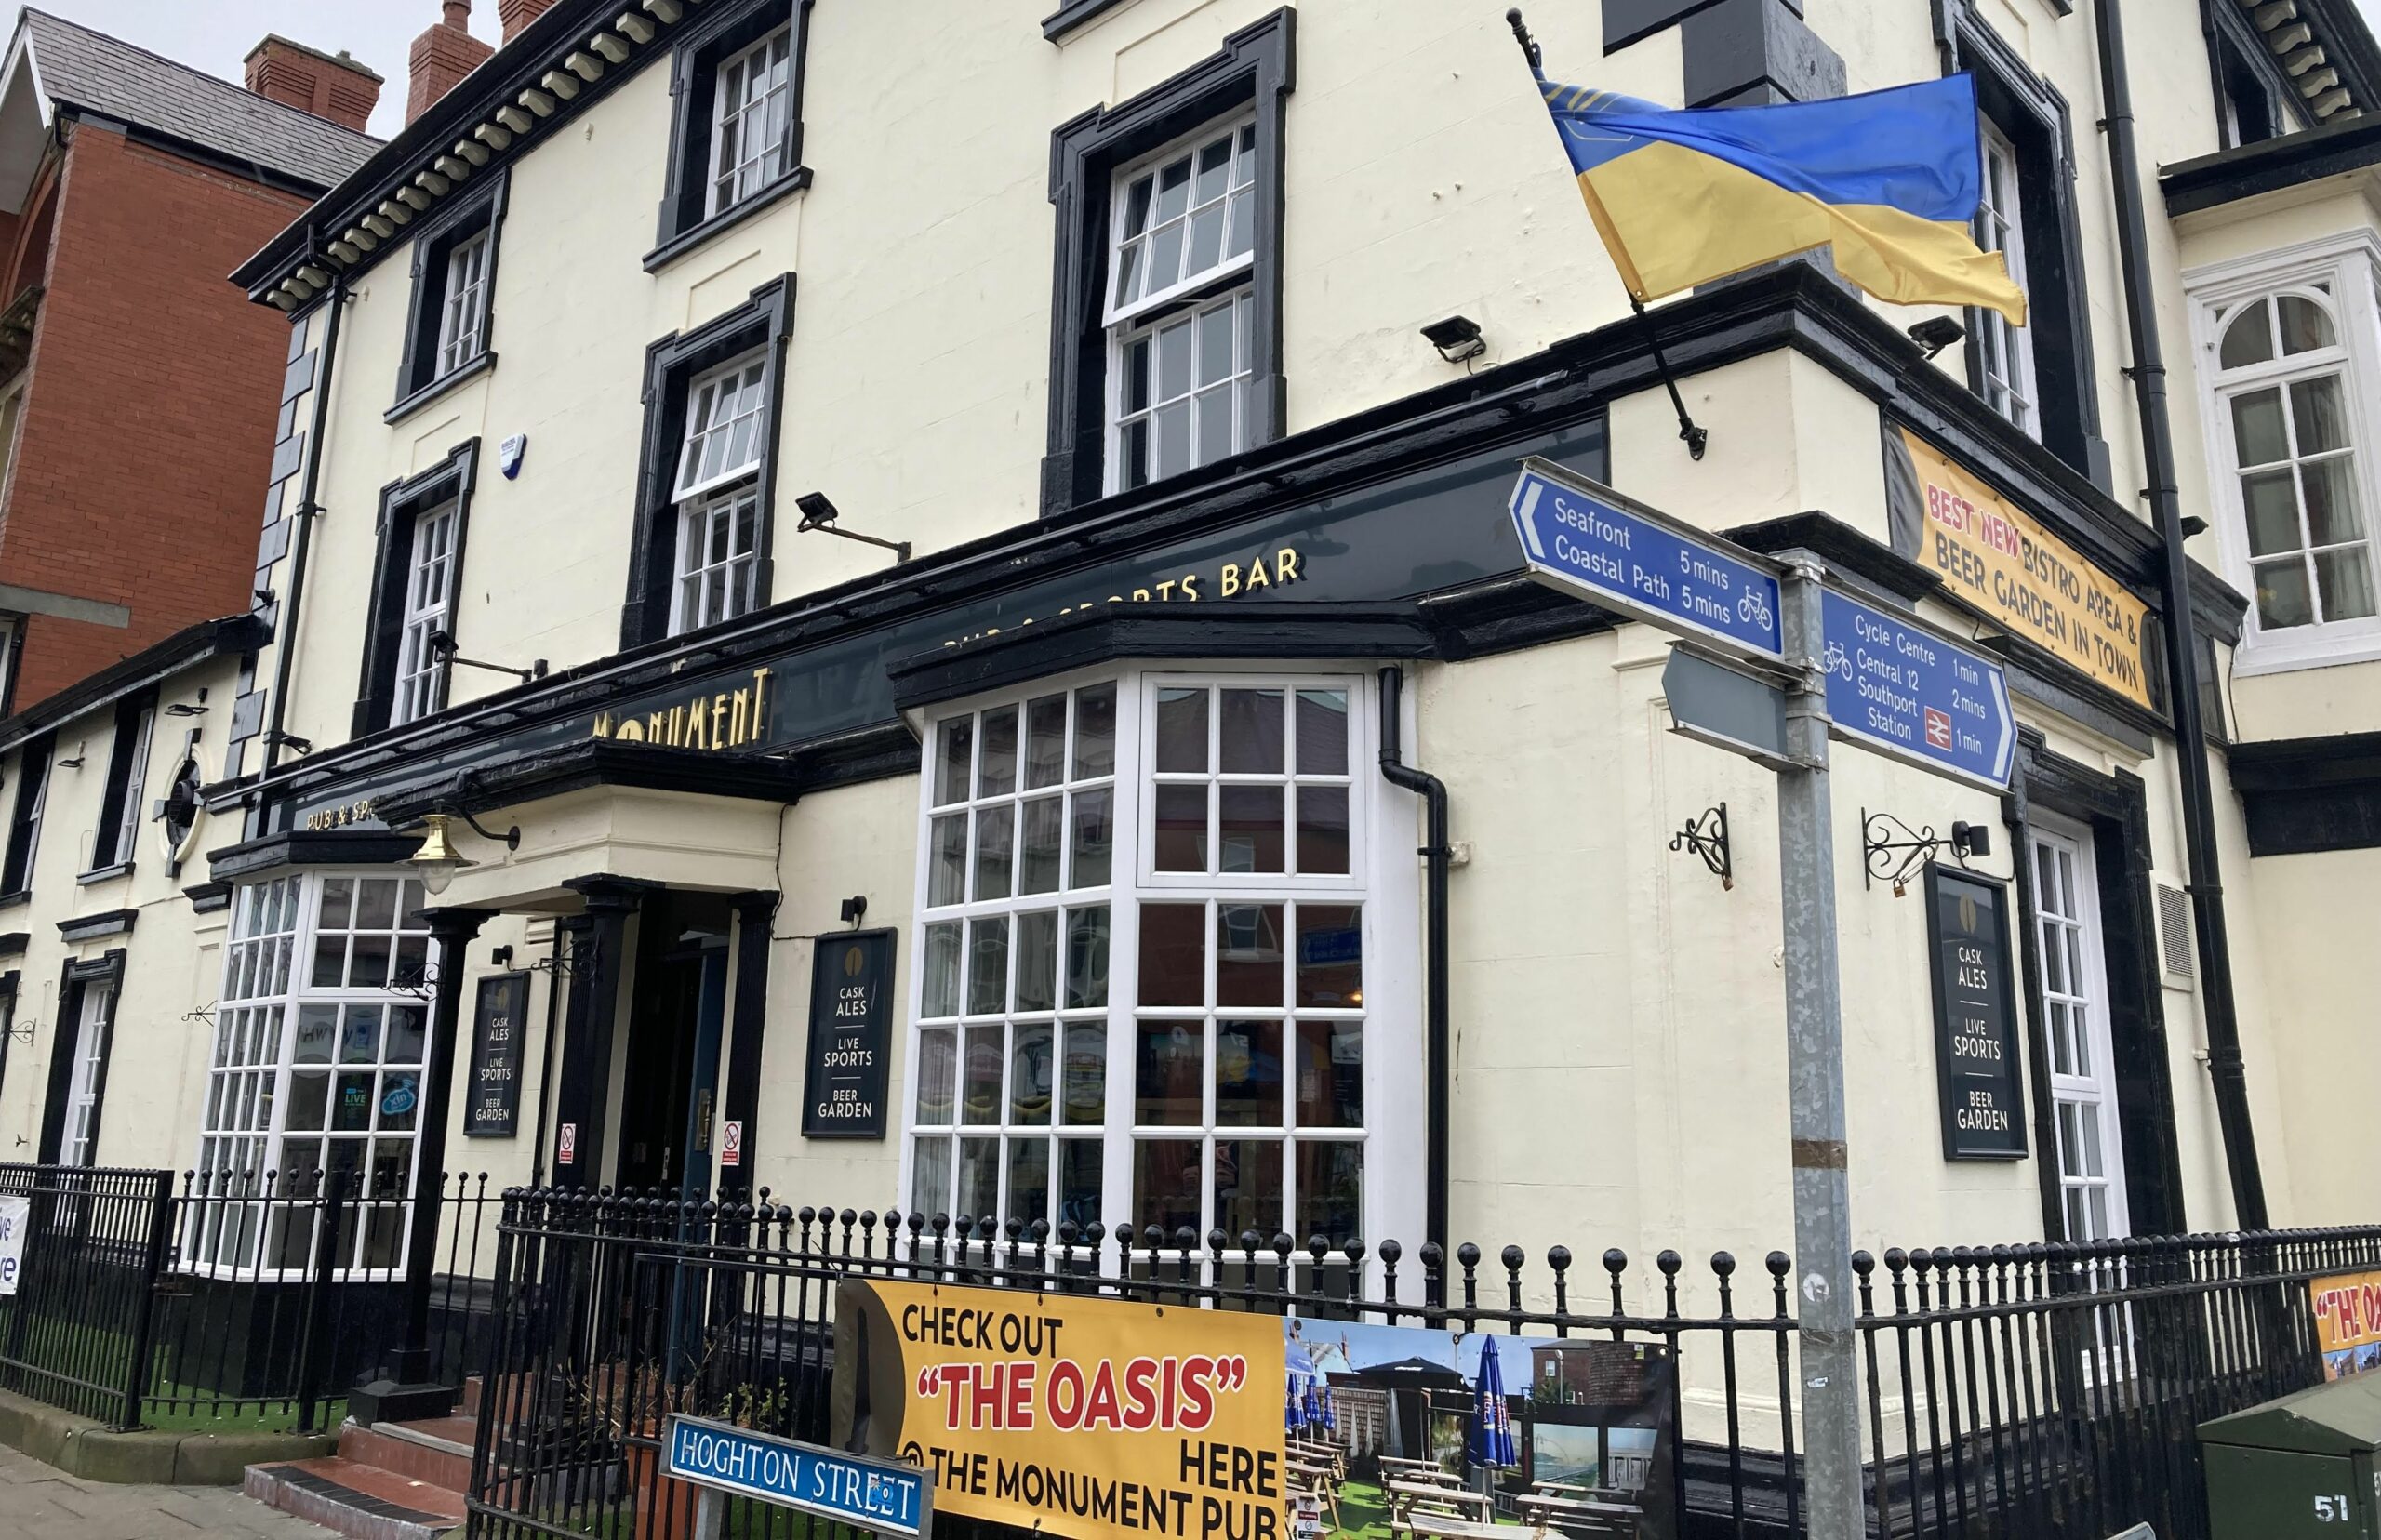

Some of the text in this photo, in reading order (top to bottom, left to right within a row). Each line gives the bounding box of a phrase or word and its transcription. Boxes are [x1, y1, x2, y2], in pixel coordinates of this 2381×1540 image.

[1554, 498, 1631, 551] Seafront
[1221, 547, 1297, 596] BAR
[1556, 535, 1625, 584] Coastal
[1633, 564, 1669, 602] Path
[1927, 483, 2137, 645] BEST NEW BISTRO AREA &
[1935, 531, 2139, 693] BEER GARDEN IN TOWN
[1856, 615, 1890, 646] Cycle
[1896, 633, 1935, 666] Centre
[1856, 648, 1902, 684] Central
[1907, 670, 1919, 691] 12
[1858, 675, 1918, 717] Southport
[1869, 707, 1912, 741] Station
[307, 810, 331, 830] PUB
[338, 805, 346, 825] &
[1958, 946, 1983, 966] CASK
[1958, 965, 1988, 990] ALES
[839, 987, 865, 999] CASK
[836, 1000, 867, 1016] ALES
[492, 1017, 509, 1028] CASK
[1965, 1017, 1987, 1036] LIVE
[489, 1029, 509, 1042] ALES
[838, 1037, 859, 1050] LIVE
[1954, 1035, 2001, 1061] SPORTS
[490, 1058, 503, 1068] LIVE
[824, 1051, 872, 1068] SPORTS
[481, 1068, 511, 1082] SPORTS
[345, 1094, 366, 1103] LIVE
[486, 1098, 501, 1109] BEER
[832, 1089, 858, 1102] BEER
[1969, 1090, 1993, 1108] BEER
[475, 1109, 510, 1122] GARDEN
[818, 1102, 871, 1118] GARDEN
[1957, 1108, 2009, 1131] GARDEN
[902, 1303, 1063, 1359] CHECK OUT
[916, 1354, 1247, 1434] “THE OASIS”
[680, 1429, 916, 1520] HOGHTON STREET
[1180, 1439, 1277, 1498] HERE
[930, 1446, 988, 1495] THE
[996, 1457, 1192, 1536] MONUMENT
[1202, 1495, 1277, 1540] PUB
[2314, 1494, 2349, 1522] 51
